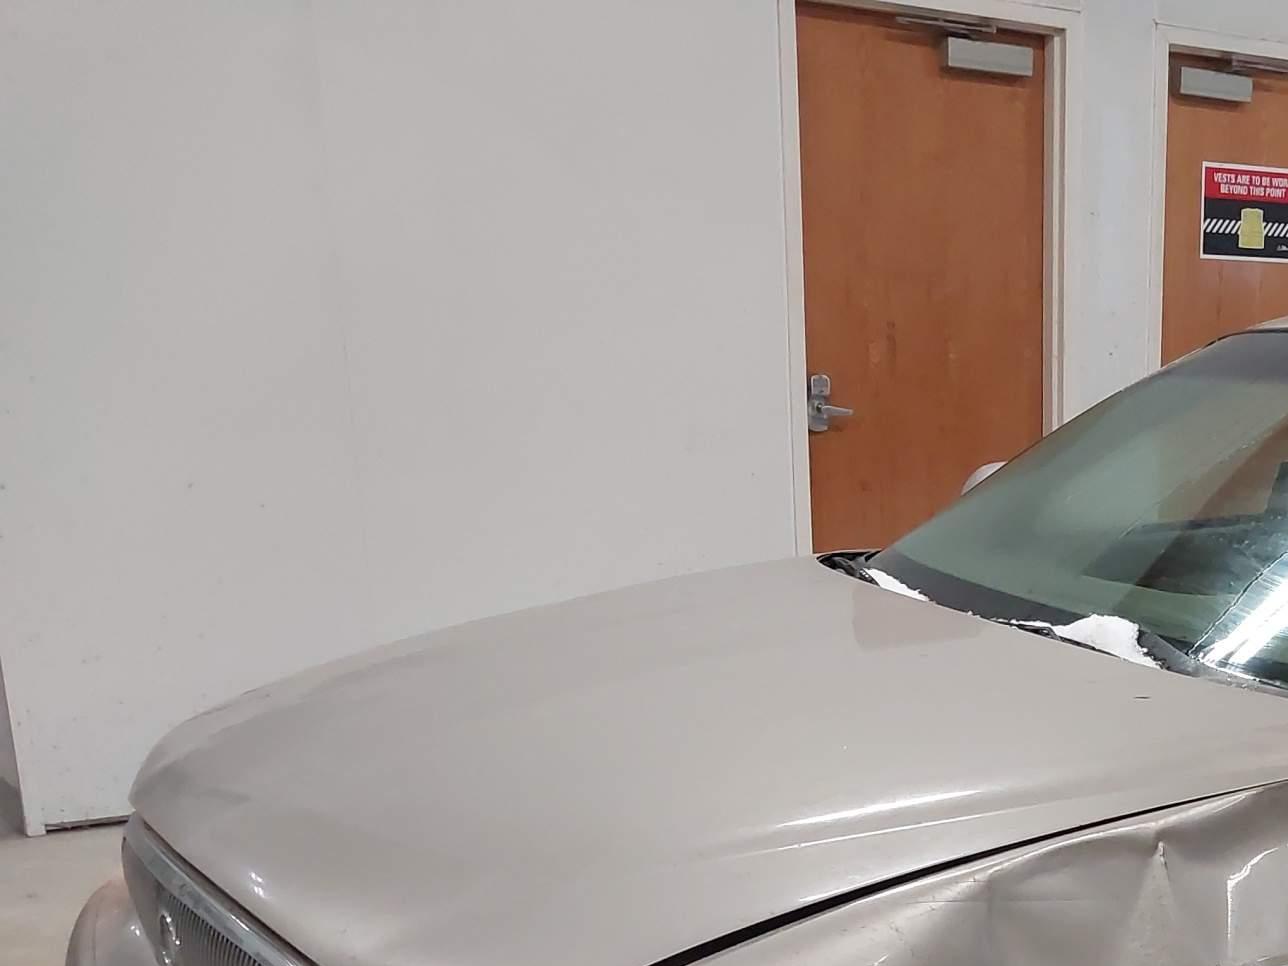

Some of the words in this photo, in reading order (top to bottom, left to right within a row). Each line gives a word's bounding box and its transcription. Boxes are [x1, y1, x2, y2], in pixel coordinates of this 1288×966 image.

[1214, 172, 1236, 183] VESTS
[1236, 174, 1250, 185] ARE
[1252, 176, 1260, 185] TO
[1261, 177, 1271, 187] BE
[1220, 184, 1248, 195] BEYOND
[1250, 186, 1265, 197] THIS
[1266, 188, 1286, 198] POINT
